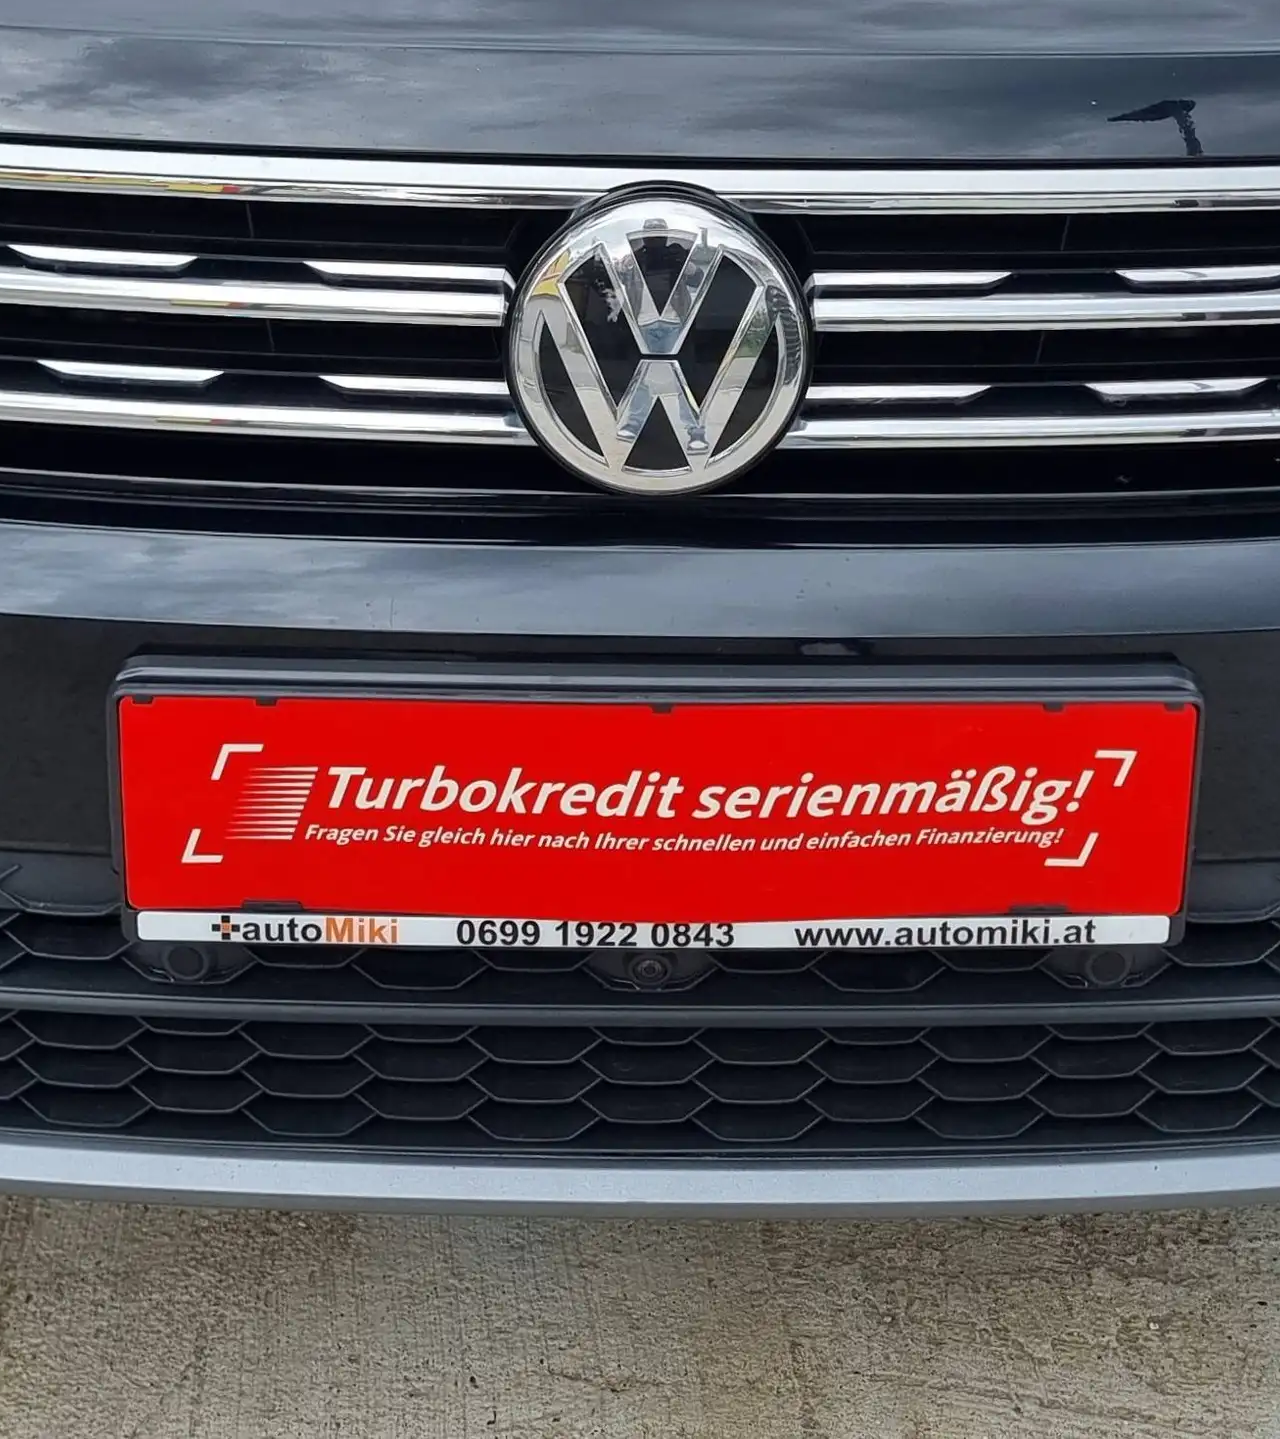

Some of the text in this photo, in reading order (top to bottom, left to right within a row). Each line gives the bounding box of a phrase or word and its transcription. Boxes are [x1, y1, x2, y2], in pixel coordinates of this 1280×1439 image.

[518, 202, 804, 488] VW
[327, 764, 1095, 826] Turbokredit serienmäßig!
[304, 823, 1065, 852] Fragen Sie gleich hier nach Ihrer schnellen und einfachen Finanzierung!
[242, 917, 1096, 948] autoMiki 0699 1922 0843 www.automiki.at
